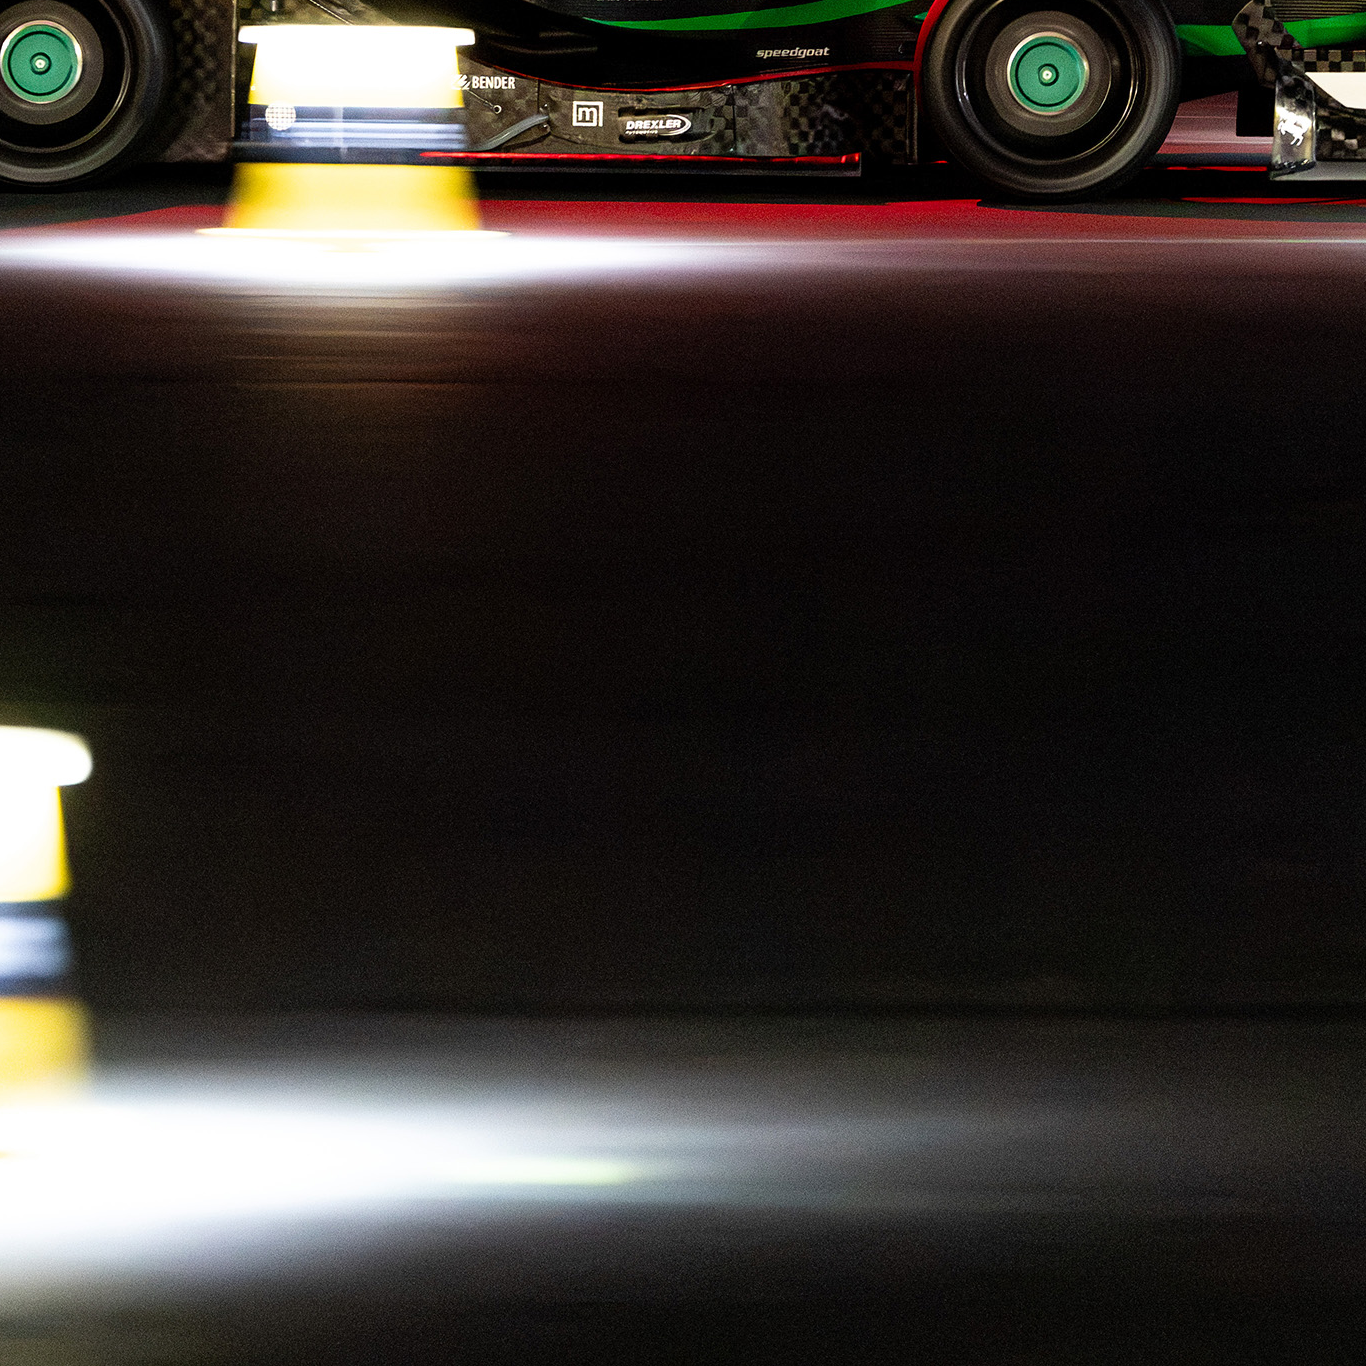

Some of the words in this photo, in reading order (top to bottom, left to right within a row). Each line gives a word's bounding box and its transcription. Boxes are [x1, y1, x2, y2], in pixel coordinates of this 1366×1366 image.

[755, 47, 830, 59] speedgoat
[471, 75, 516, 90] BENDER
[626, 119, 682, 130] DREXLER
